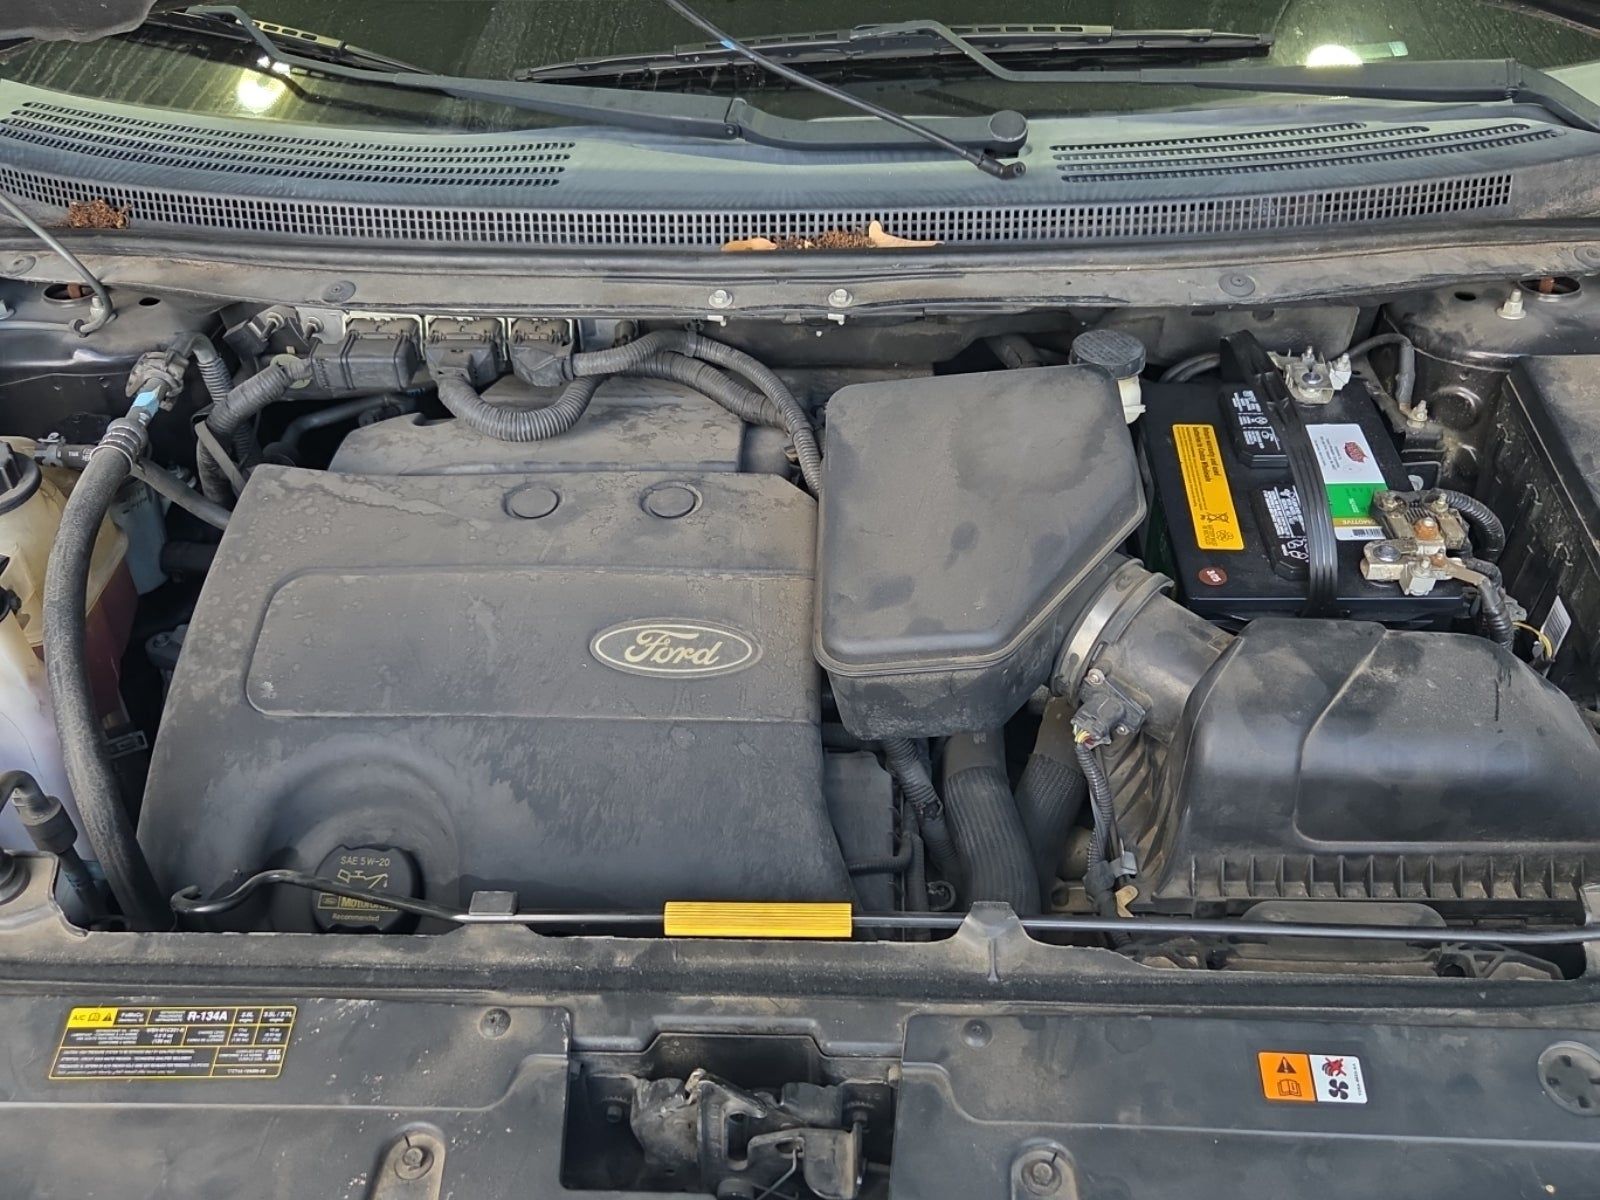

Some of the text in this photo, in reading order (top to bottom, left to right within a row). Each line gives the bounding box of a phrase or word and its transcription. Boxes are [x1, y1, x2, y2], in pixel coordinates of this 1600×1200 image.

[624, 629, 723, 665] Ford
[340, 855, 391, 867] SAE 5W-20
[332, 912, 379, 921] Recommended
[187, 1010, 228, 1021] R-134A
